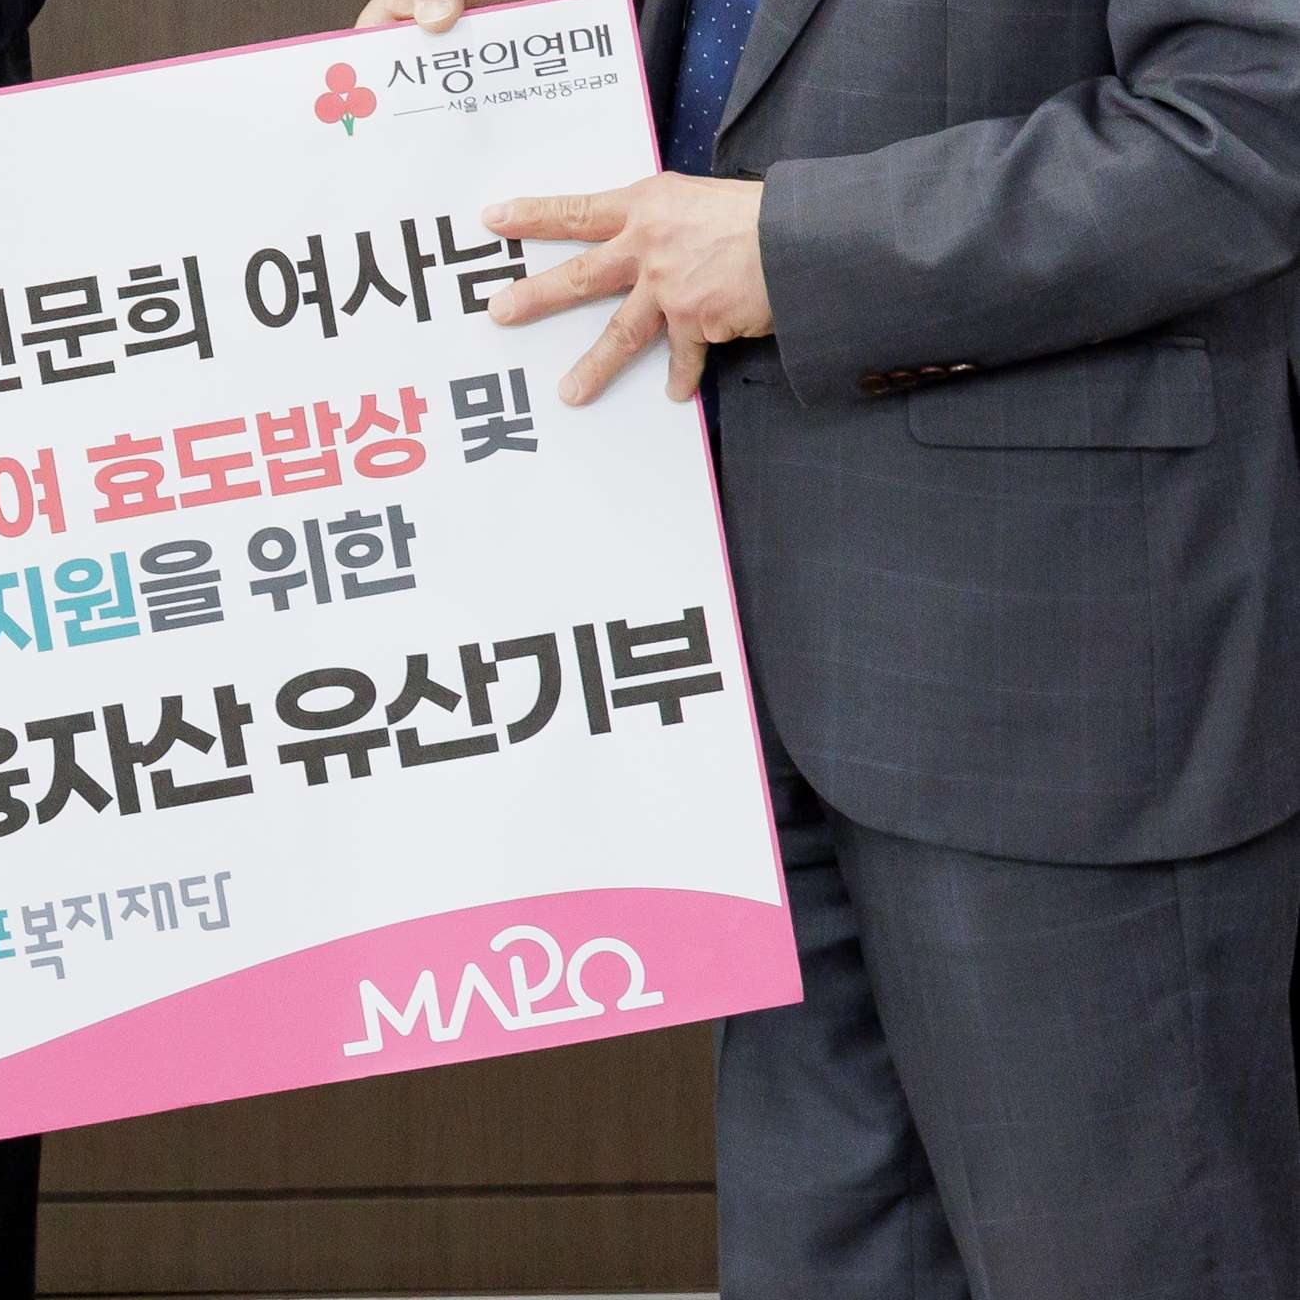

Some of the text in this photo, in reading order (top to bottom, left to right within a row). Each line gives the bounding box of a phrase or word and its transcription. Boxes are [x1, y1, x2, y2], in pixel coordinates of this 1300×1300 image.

[387, 23, 614, 94] 사랑의열매
[447, 72, 619, 113] 서울 사회복지공동모금회
[245, 214, 527, 339] 여사님
[86, 386, 428, 524] 효도밥상
[449, 367, 538, 464] 및
[247, 504, 417, 613] 위한
[275, 606, 725, 787] 유산기부
[343, 924, 664, 1057] MAPO
